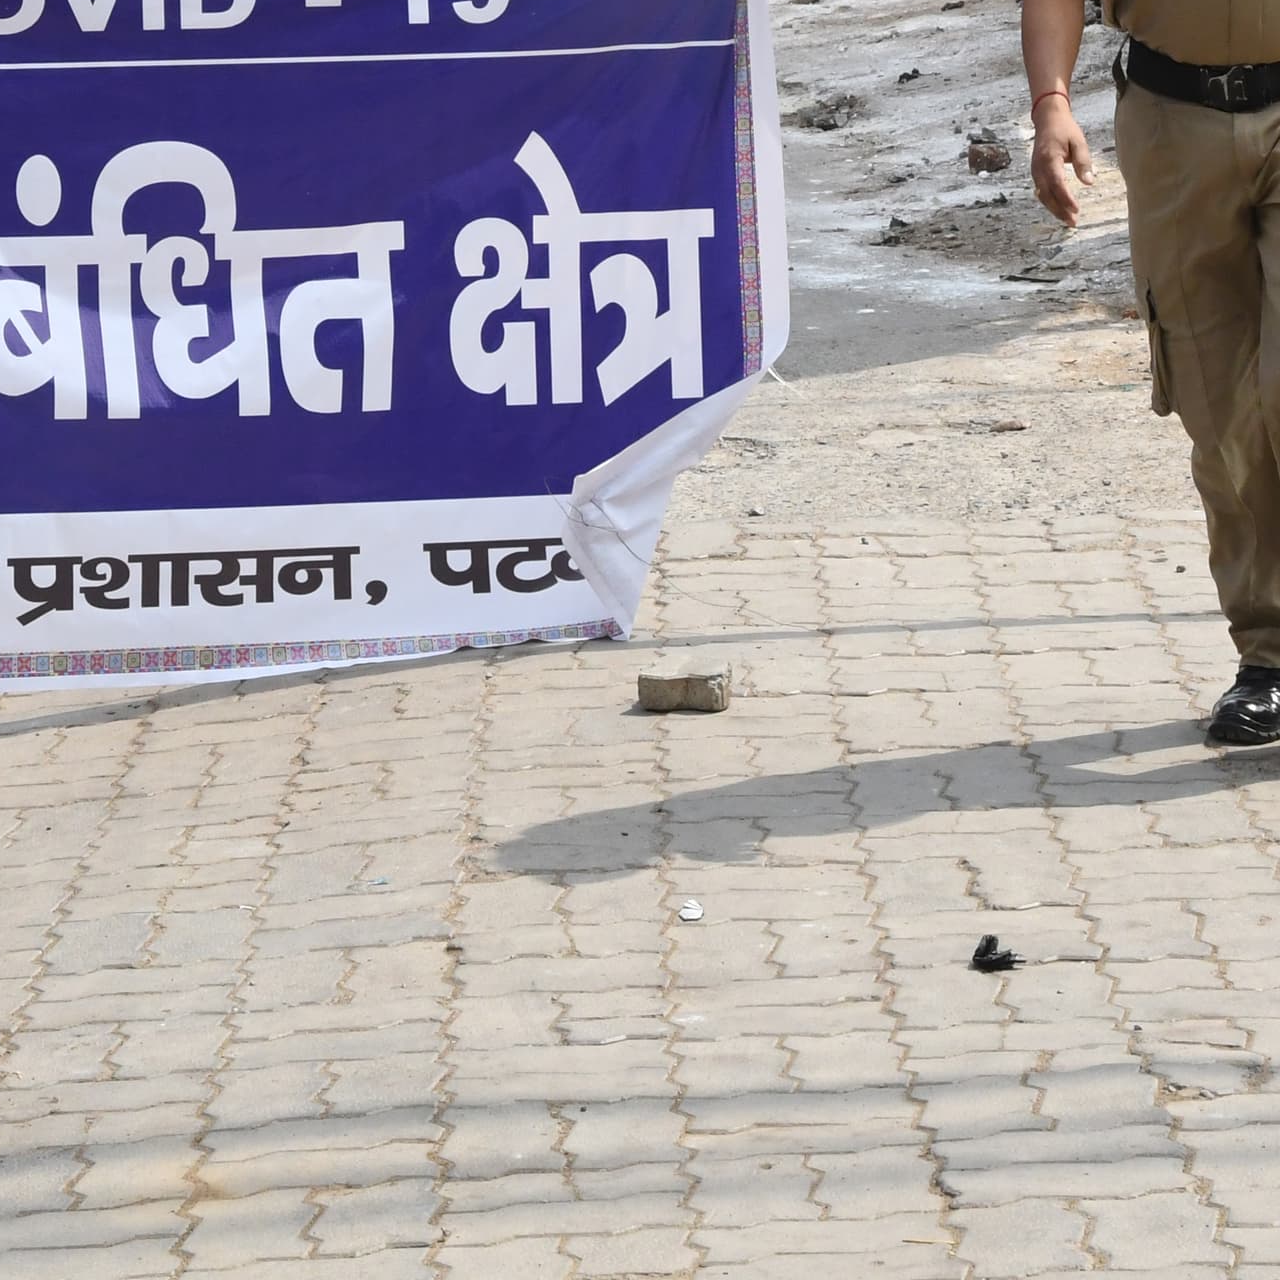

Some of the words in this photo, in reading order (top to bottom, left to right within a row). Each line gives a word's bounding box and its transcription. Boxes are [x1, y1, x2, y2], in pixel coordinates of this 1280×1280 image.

[448, 129, 716, 407] क्षेत्र
[7, 543, 389, 628] प्रशासन,
[423, 535, 590, 596] पट
